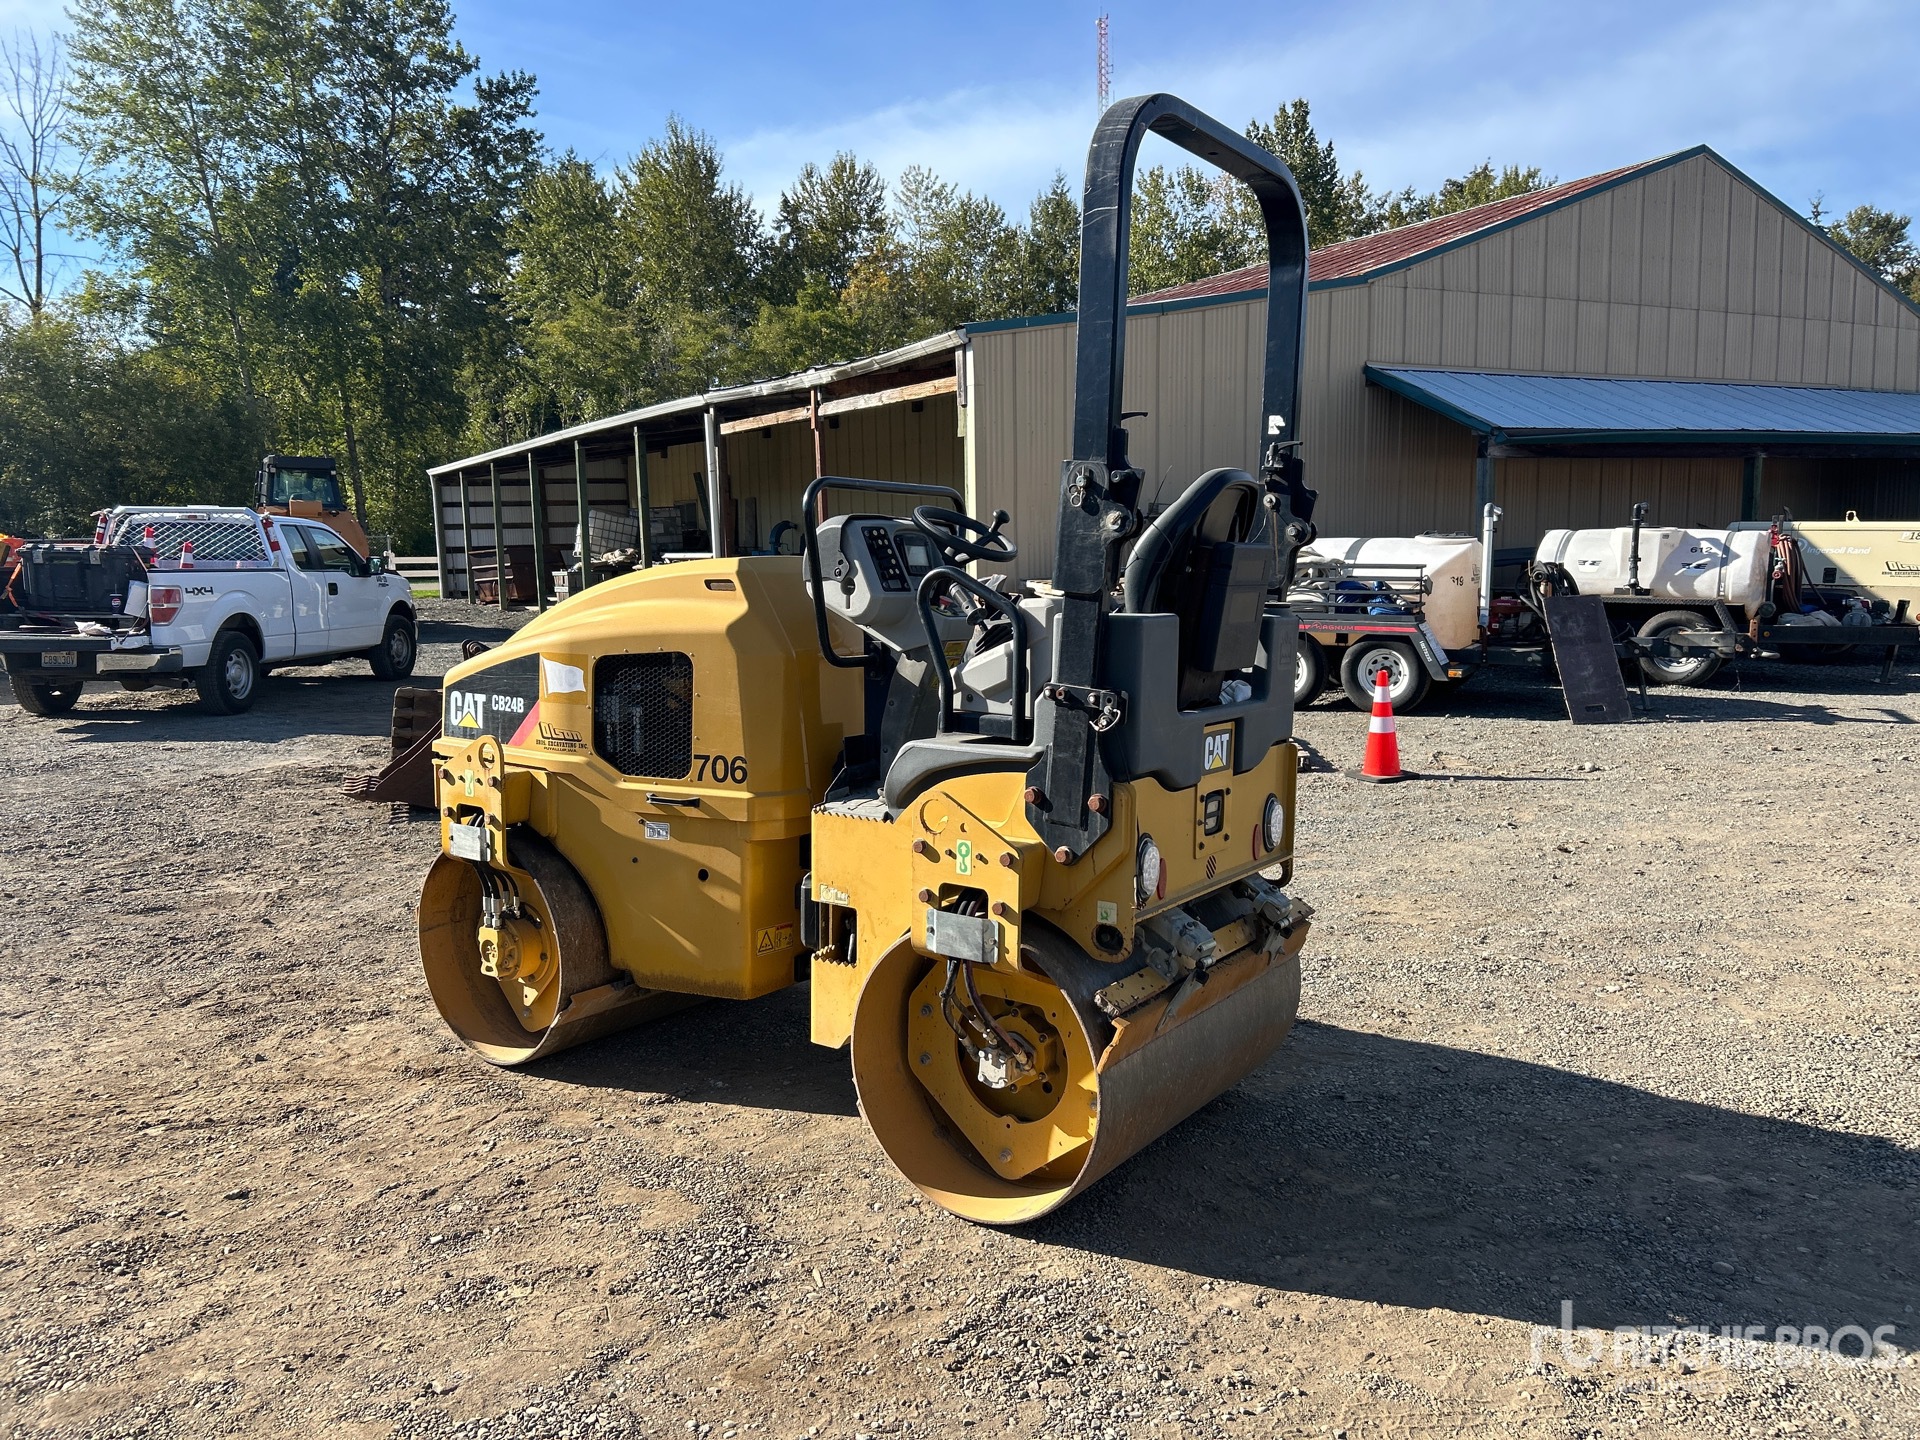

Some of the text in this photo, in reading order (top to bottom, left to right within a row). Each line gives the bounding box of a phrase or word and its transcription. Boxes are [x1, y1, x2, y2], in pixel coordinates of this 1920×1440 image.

[1807, 546, 1871, 555] Ingersoll Rand
[450, 690, 524, 729] CAT CB24B
[1204, 733, 1230, 770] CAT
[693, 754, 748, 784] 706
